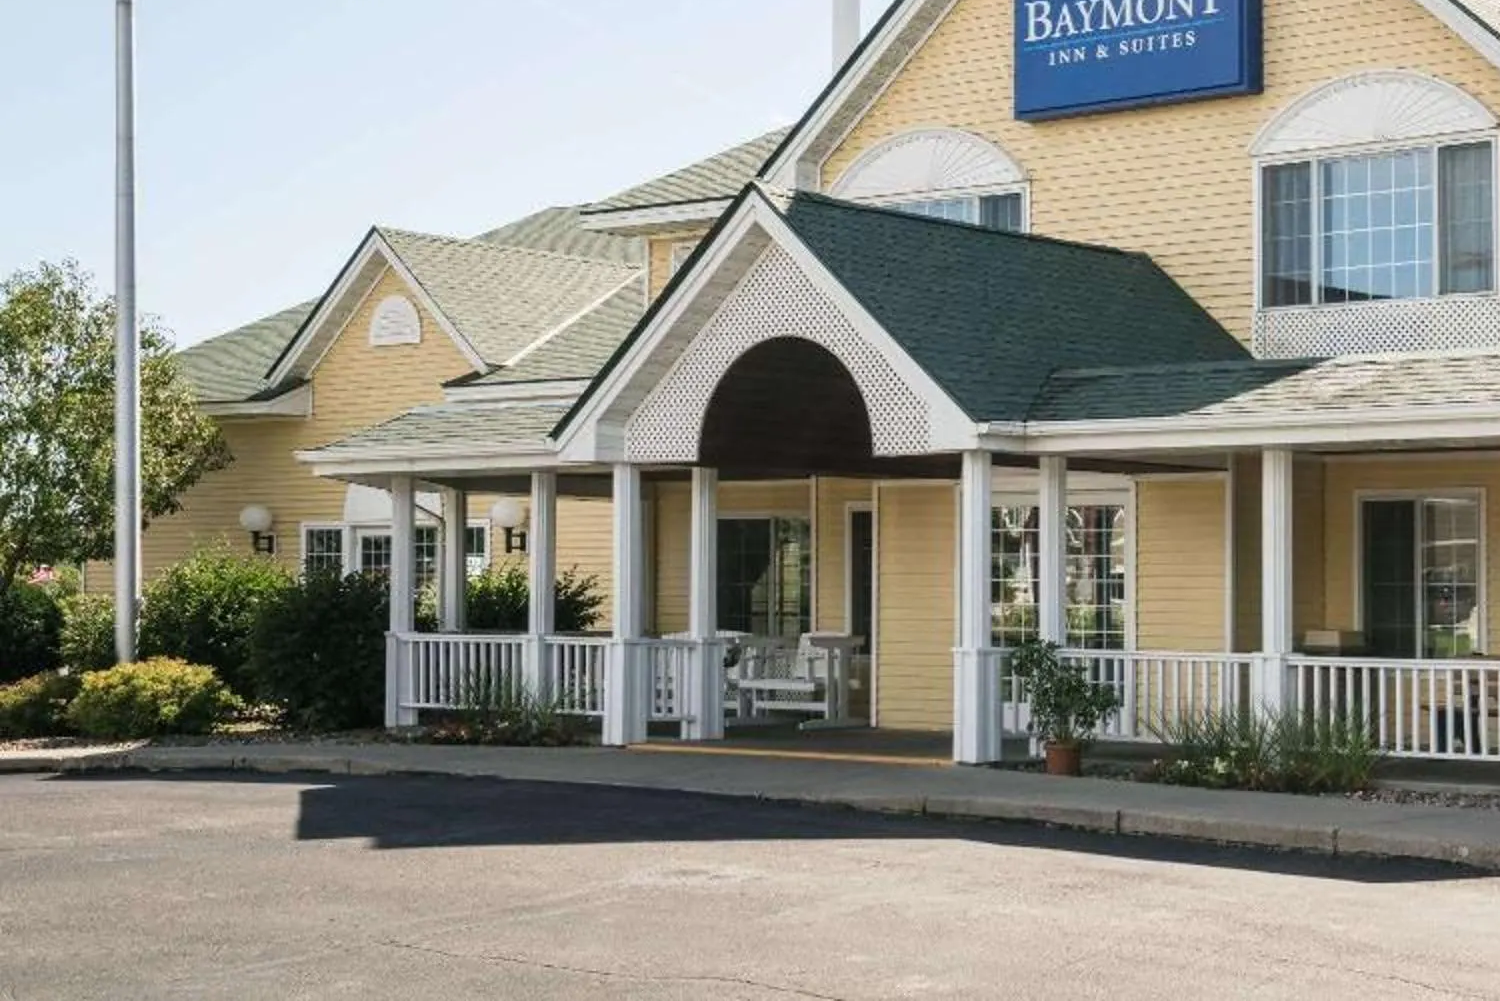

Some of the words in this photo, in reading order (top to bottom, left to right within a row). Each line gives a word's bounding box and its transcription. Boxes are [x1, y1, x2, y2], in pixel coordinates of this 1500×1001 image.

[1048, 46, 1087, 66] INN
[1096, 44, 1109, 59] &
[1119, 29, 1197, 56] SUITES
